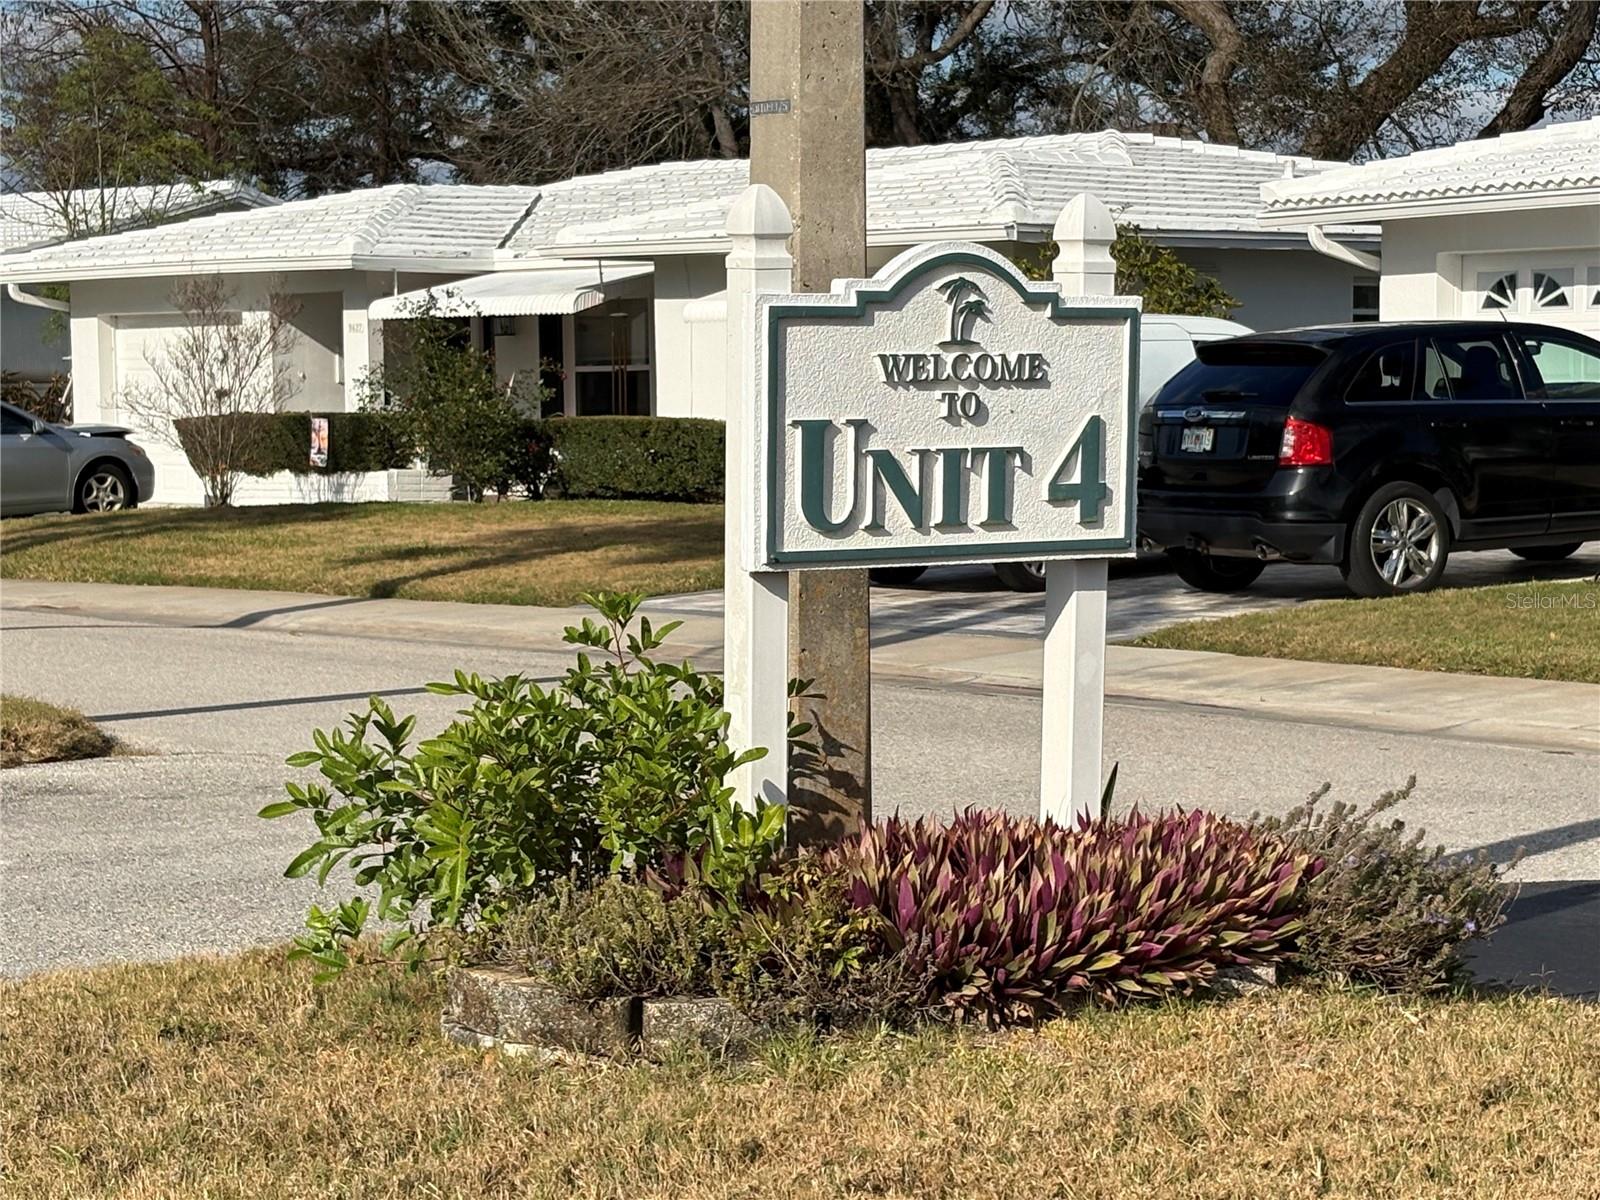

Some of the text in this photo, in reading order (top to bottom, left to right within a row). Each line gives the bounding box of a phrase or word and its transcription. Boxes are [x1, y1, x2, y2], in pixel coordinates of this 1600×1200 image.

[878, 353, 1046, 383] WELCOME
[940, 392, 981, 418] TO
[788, 415, 1107, 533] UNIT 4
